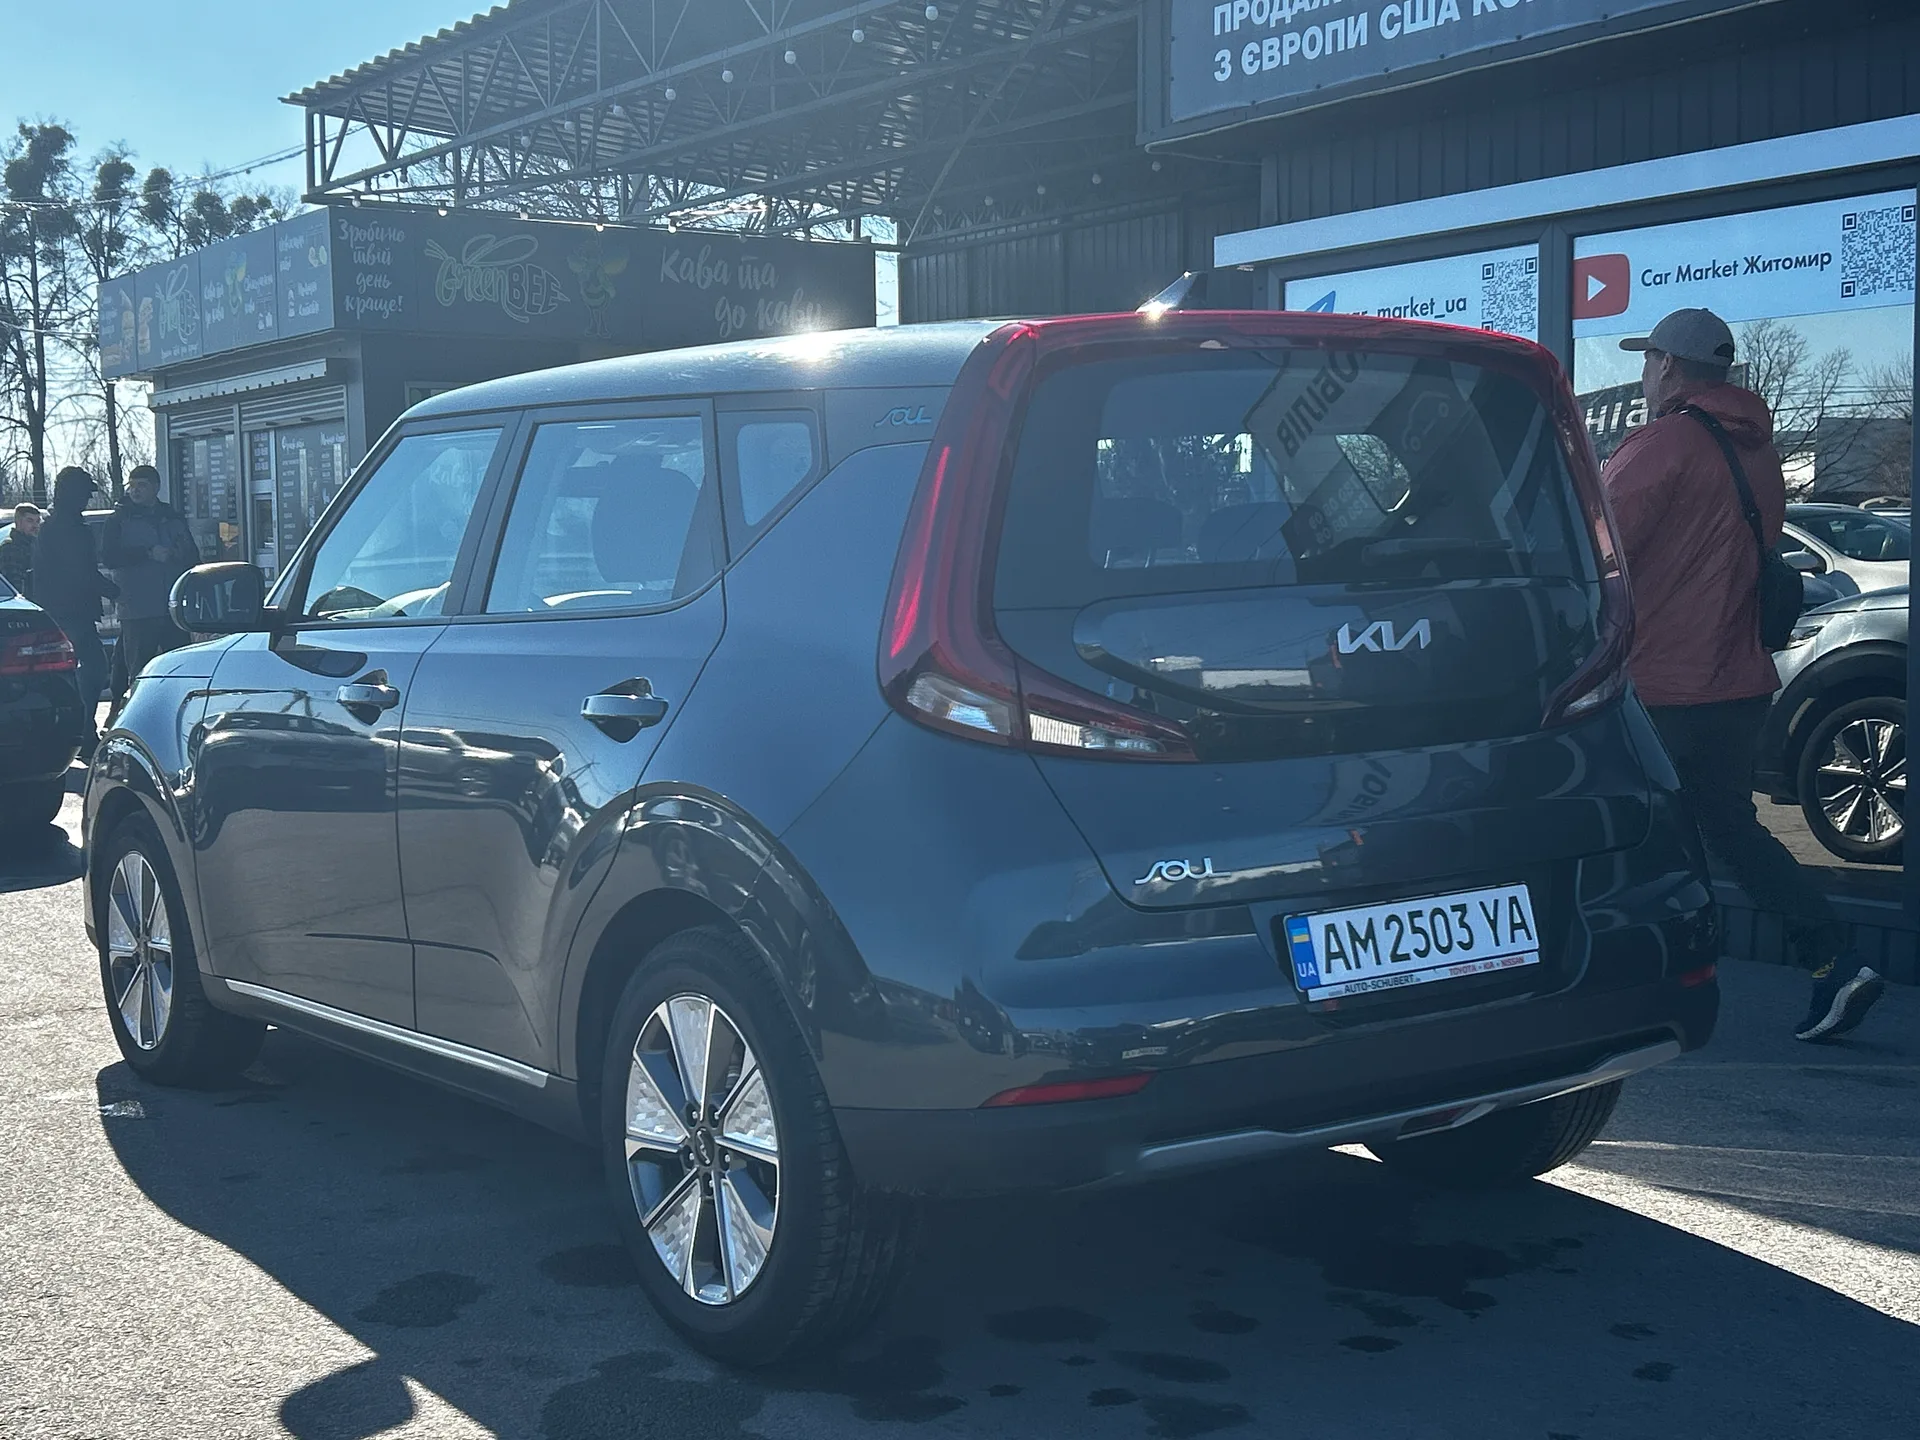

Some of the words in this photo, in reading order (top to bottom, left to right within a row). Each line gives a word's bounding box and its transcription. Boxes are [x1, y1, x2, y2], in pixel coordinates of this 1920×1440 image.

[1241, 12, 1368, 76] ЄВРОПИ
[1379, 0, 1461, 40] США
[352, 245, 394, 267] твій
[660, 244, 732, 290] Кава
[737, 256, 779, 291] та
[1641, 268, 1672, 287] Car
[1675, 259, 1739, 283] Market
[1743, 251, 1832, 275] Житомир
[355, 271, 393, 295] день
[344, 295, 403, 321] краще!
[714, 296, 747, 339] до
[873, 406, 932, 427] SOUL
[1337, 618, 1432, 654] KIA
[1134, 857, 1232, 885] SOUL
[1324, 917, 1382, 974] AM
[1384, 903, 1474, 963] 2503
[1479, 895, 1533, 947] YA
[1298, 961, 1318, 979] UA
[1449, 964, 1477, 976] TOYOTA
[1501, 956, 1524, 968] NISSAN
